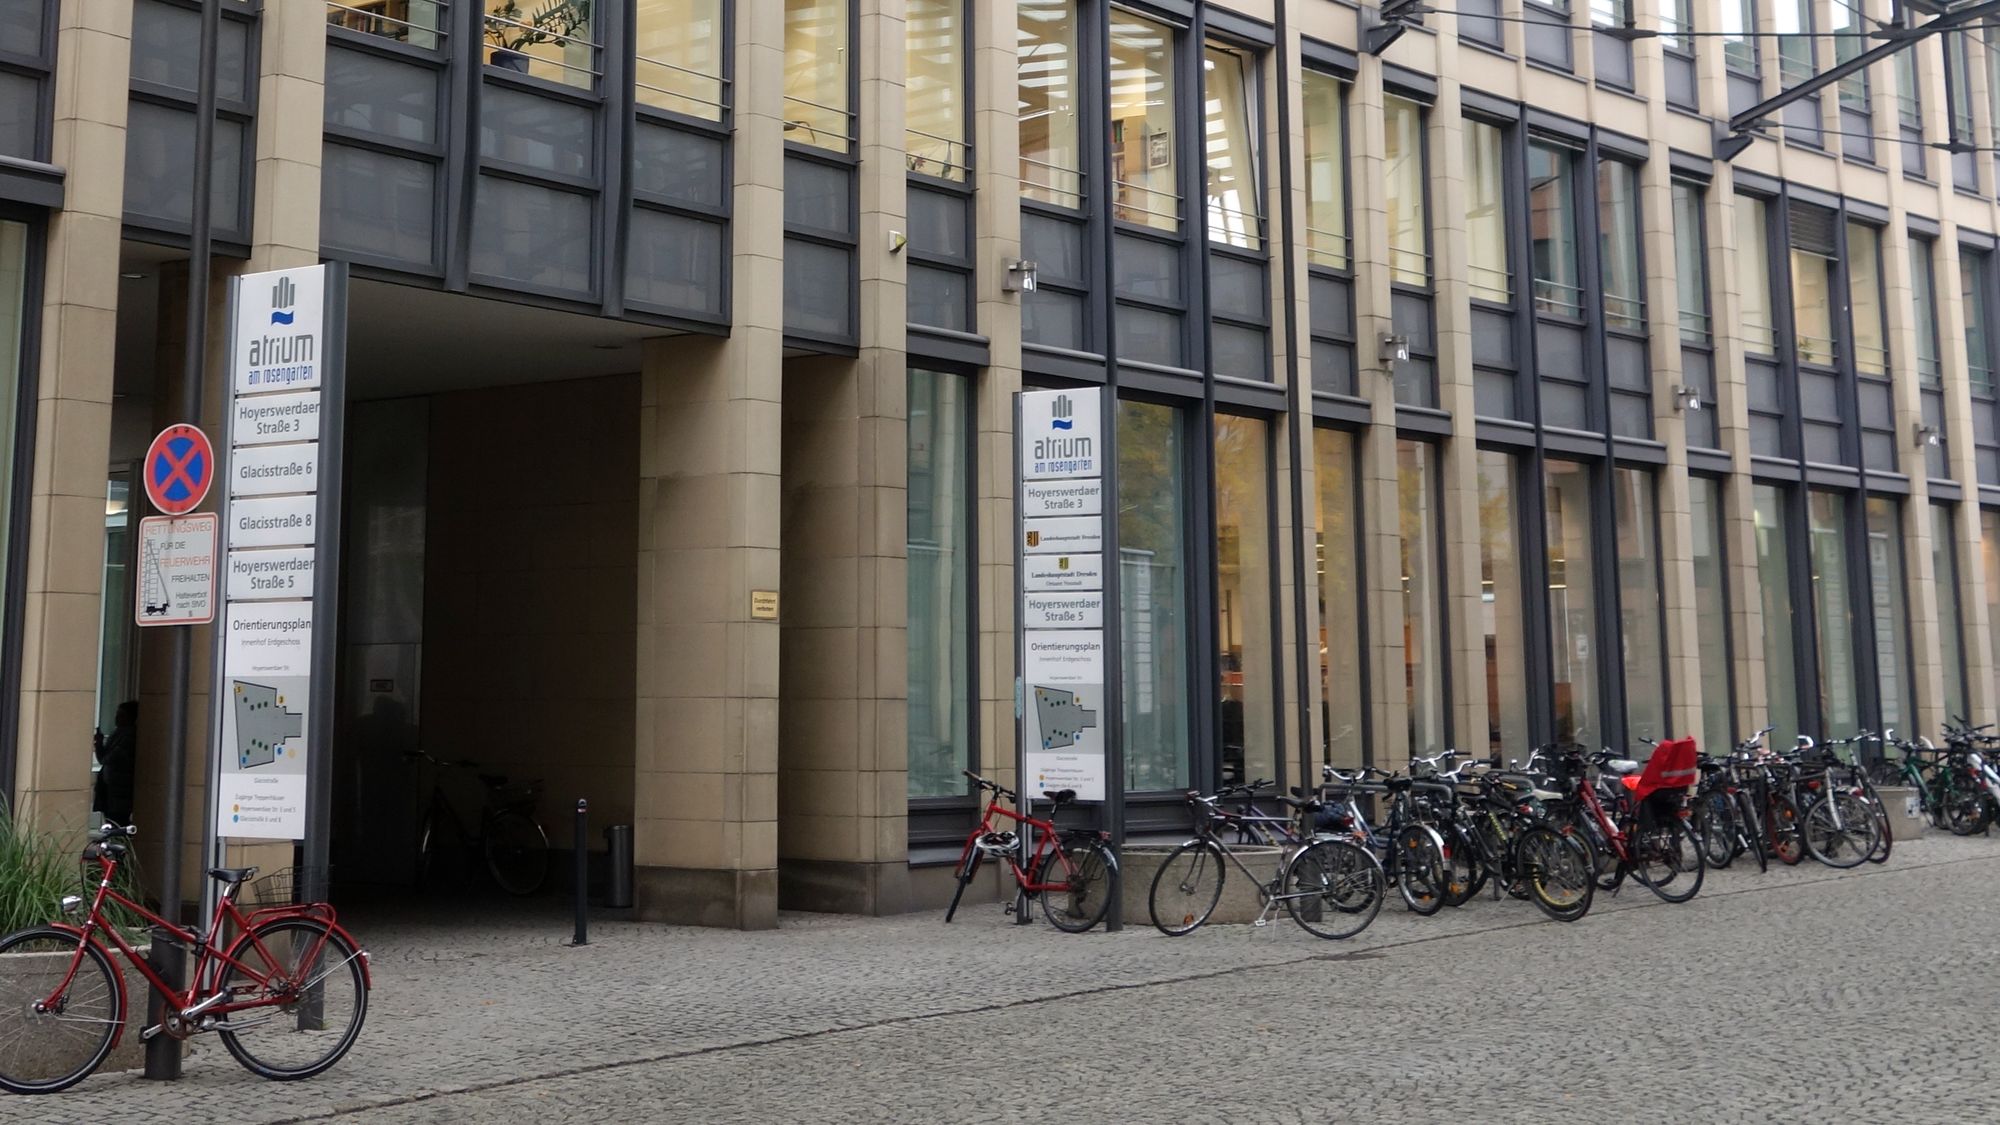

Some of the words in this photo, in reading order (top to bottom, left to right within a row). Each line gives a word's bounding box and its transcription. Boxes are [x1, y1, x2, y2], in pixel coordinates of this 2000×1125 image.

[249, 334, 313, 367] atrium
[248, 370, 260, 385] am
[263, 365, 313, 385] rosengarten
[239, 401, 320, 421] Hoyerswerdaer
[256, 419, 290, 435] Straße
[293, 419, 300, 432] 3
[1034, 436, 1091, 459] atrium
[240, 462, 303, 479] Glacisstraße
[305, 461, 312, 475] 6
[1034, 462, 1046, 473] am
[1047, 459, 1092, 474] rosengarten
[1028, 485, 1099, 500] Hoyerswerdaer
[1044, 498, 1075, 510] Straße
[1077, 498, 1083, 509] 3
[145, 521, 212, 535] RETTUNGSWEG
[239, 514, 302, 530] Glacisstraße
[305, 513, 312, 527] 8
[233, 557, 316, 576] Hoyerswerdaer
[250, 575, 285, 590] Straße
[288, 575, 294, 588] 5
[1028, 598, 1100, 611] Hoyerswerdaer
[1045, 610, 1075, 622] Straße
[1078, 611, 1084, 621] 5
[232, 617, 312, 633] Orientierungsplan
[1030, 641, 1101, 653] Orientierungsplan
